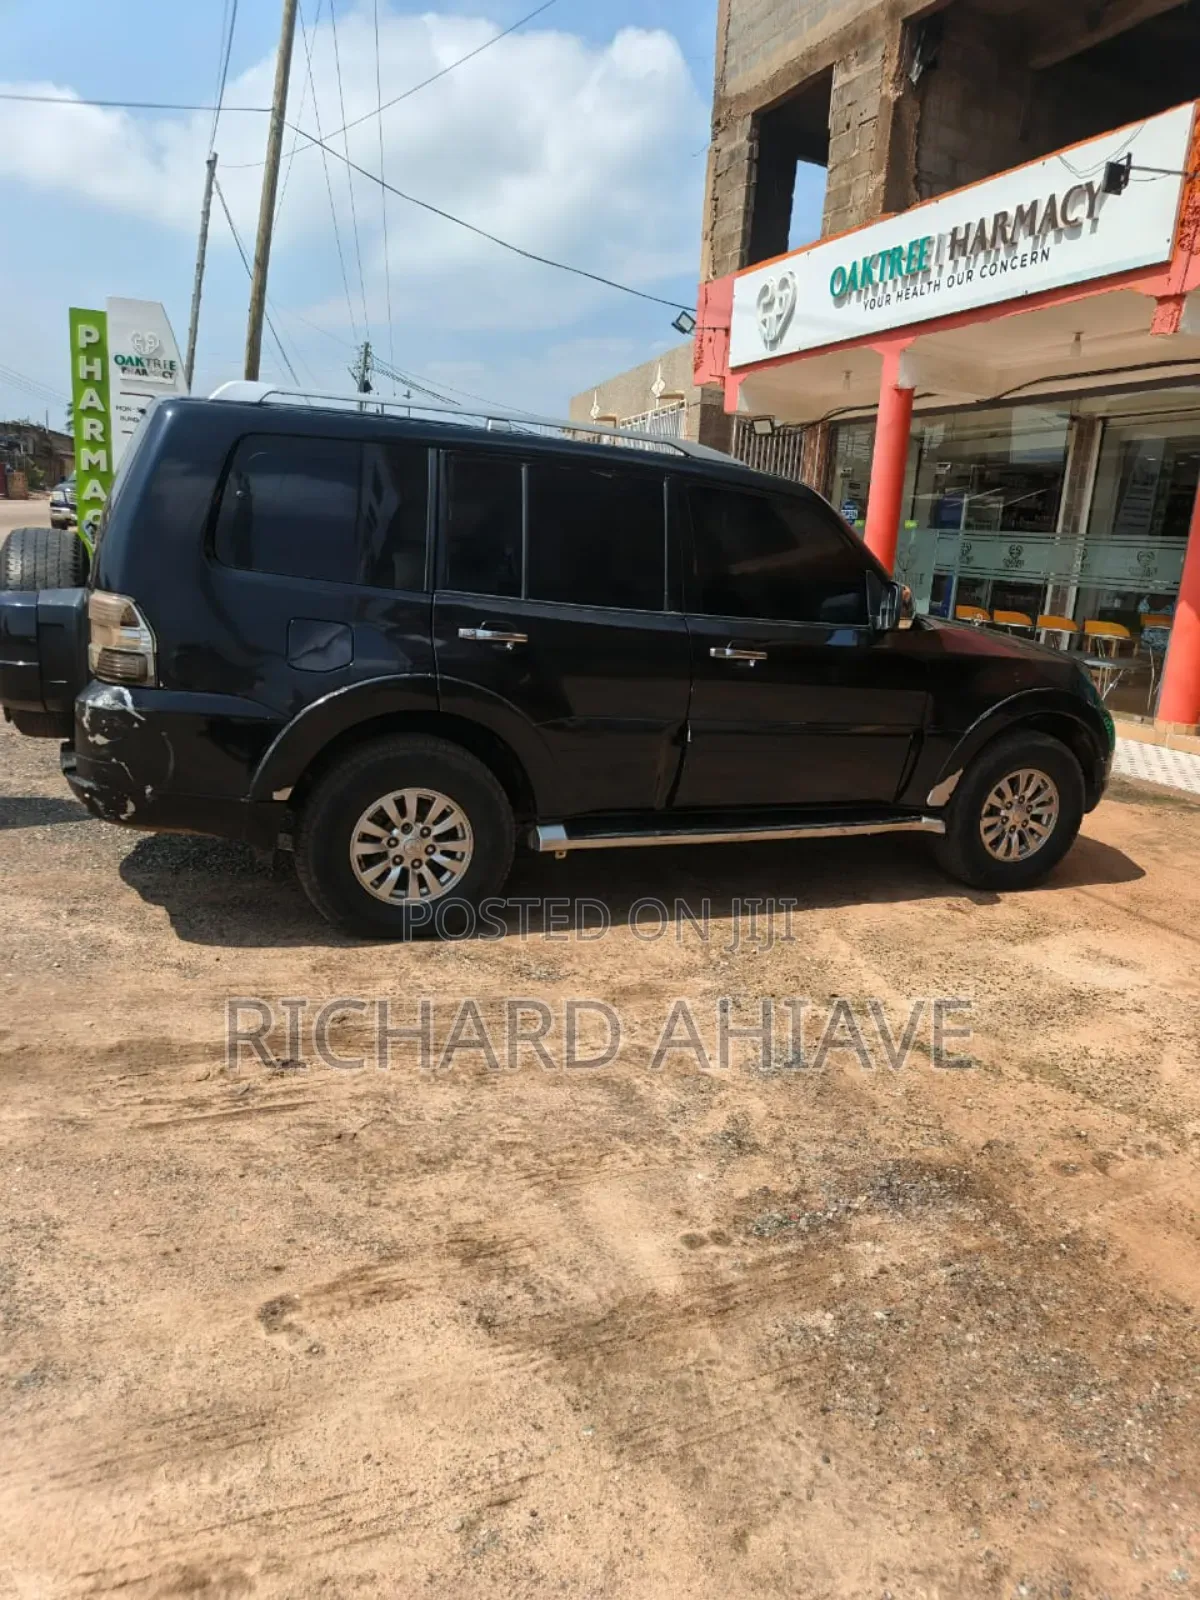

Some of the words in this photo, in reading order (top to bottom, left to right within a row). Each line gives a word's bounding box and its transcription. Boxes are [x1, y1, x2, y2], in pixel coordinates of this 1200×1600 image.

[829, 235, 933, 298] OAKTREE
[863, 294, 891, 312] YOUR
[896, 279, 941, 303] HEALTH
[946, 269, 974, 288] OUR
[979, 247, 1050, 279] CONCERN
[77, 324, 108, 532] PHARMAC
